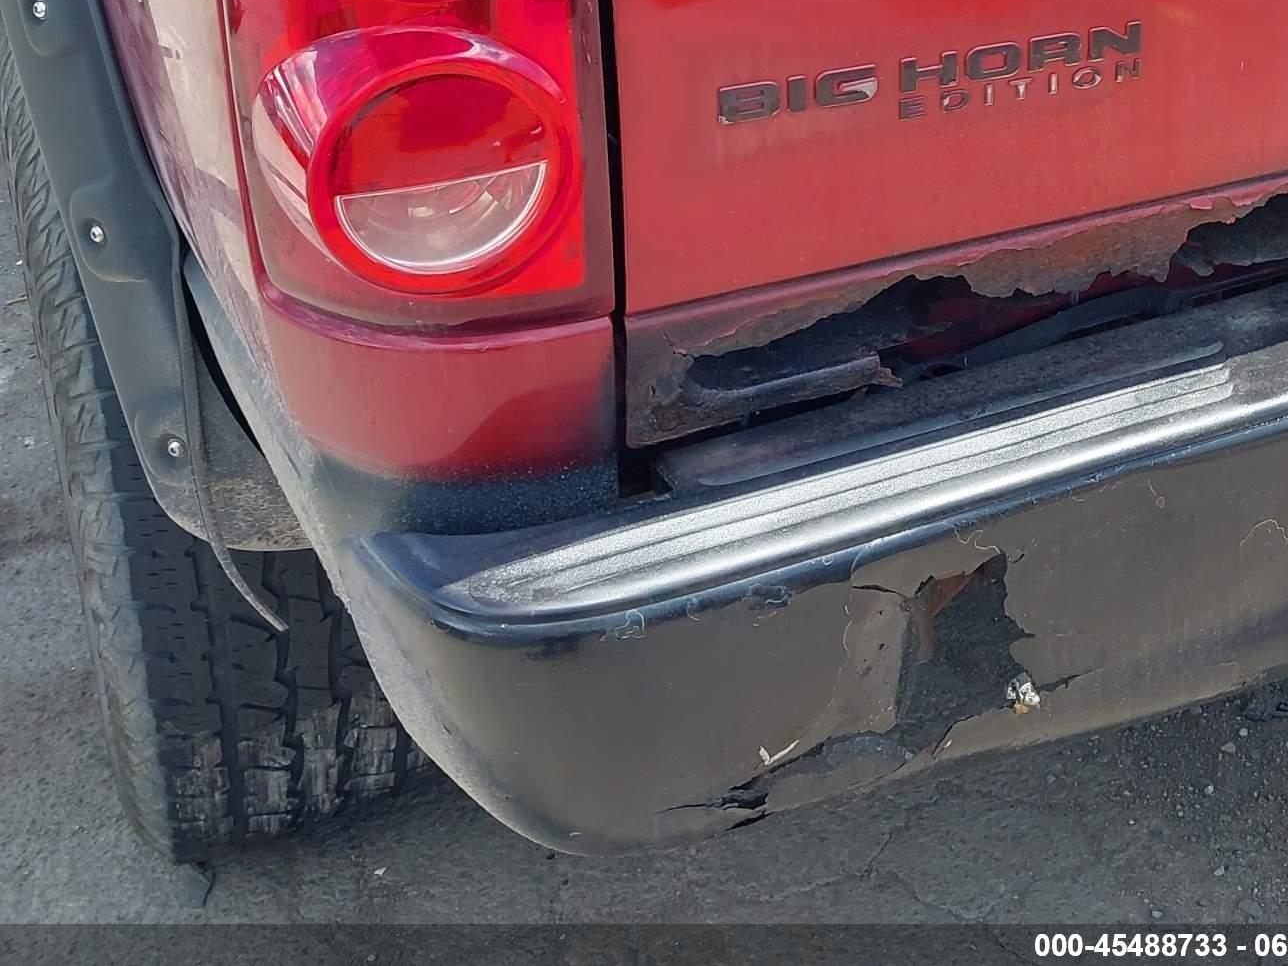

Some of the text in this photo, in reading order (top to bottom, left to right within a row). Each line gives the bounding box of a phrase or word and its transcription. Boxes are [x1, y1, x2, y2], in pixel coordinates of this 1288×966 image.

[717, 20, 1142, 124] BIG HORN
[898, 58, 1142, 122] EDITION
